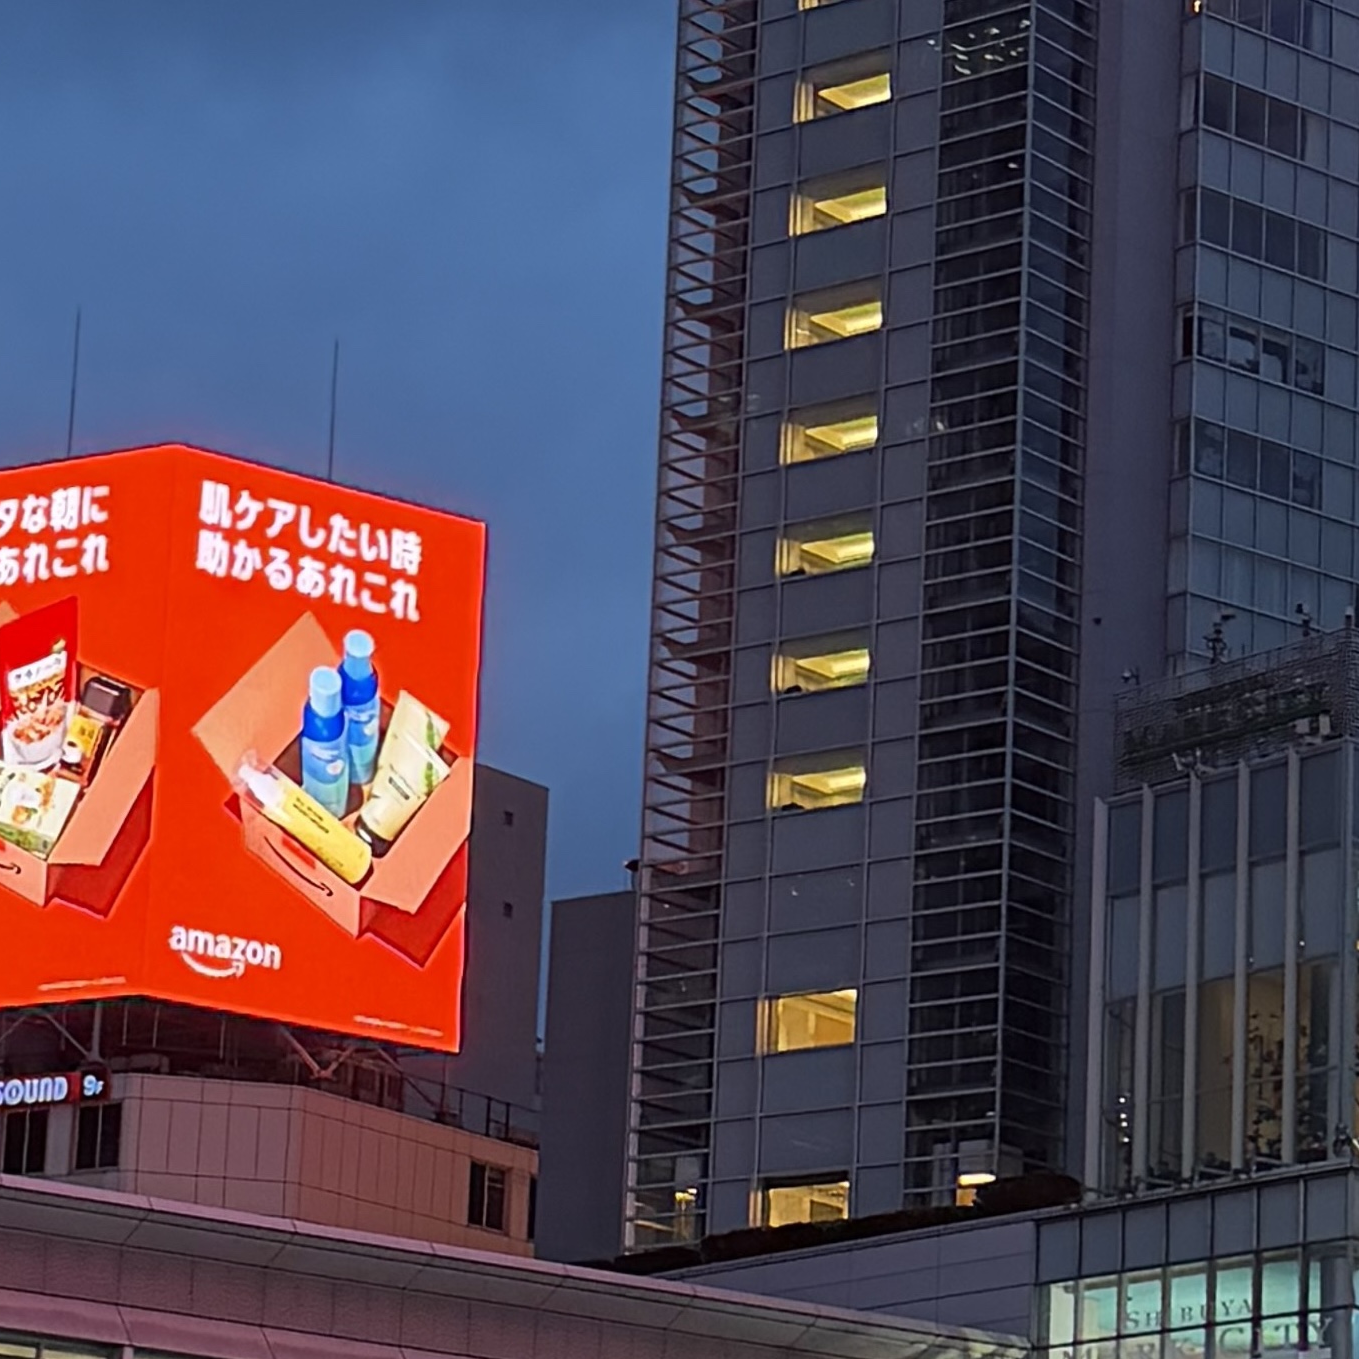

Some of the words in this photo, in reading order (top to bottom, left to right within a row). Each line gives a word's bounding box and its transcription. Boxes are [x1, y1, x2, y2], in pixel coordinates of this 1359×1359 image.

[198, 479, 423, 576] 肌ケアしたい時
[195, 528, 421, 623] 助かるあれこれ
[168, 925, 282, 972] amazon
